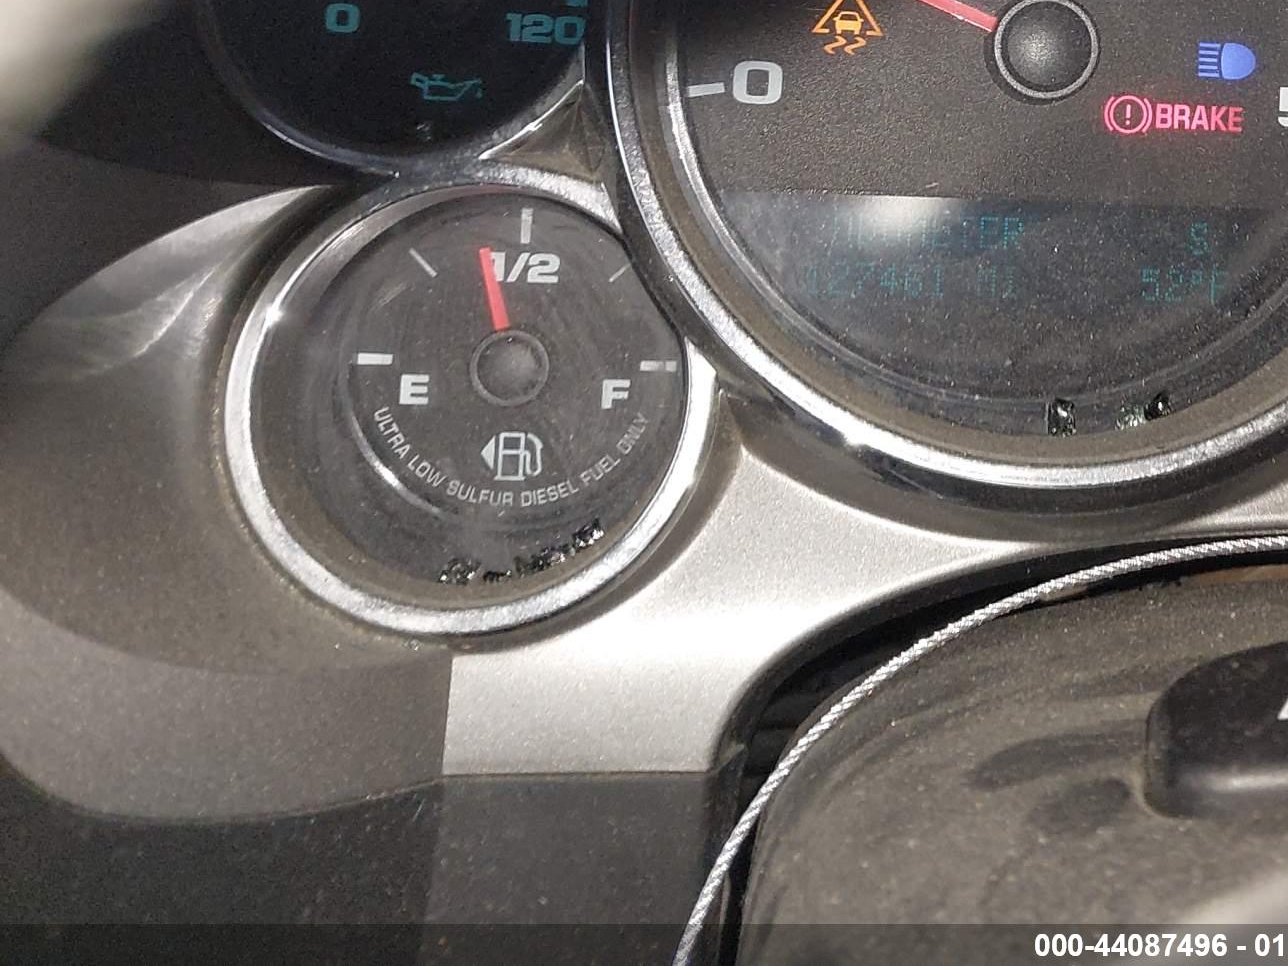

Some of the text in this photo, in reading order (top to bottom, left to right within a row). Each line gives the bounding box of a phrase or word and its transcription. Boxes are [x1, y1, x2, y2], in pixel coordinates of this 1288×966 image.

[324, 2, 361, 34] 0
[506, 12, 587, 46] 120
[732, 61, 783, 105] 0
[1155, 104, 1243, 133] BRAKE
[399, 374, 430, 405] E
[601, 379, 631, 410] F
[374, 406, 648, 507] ULTRA LOW SULFUR DIESEL FUEL ONLY
